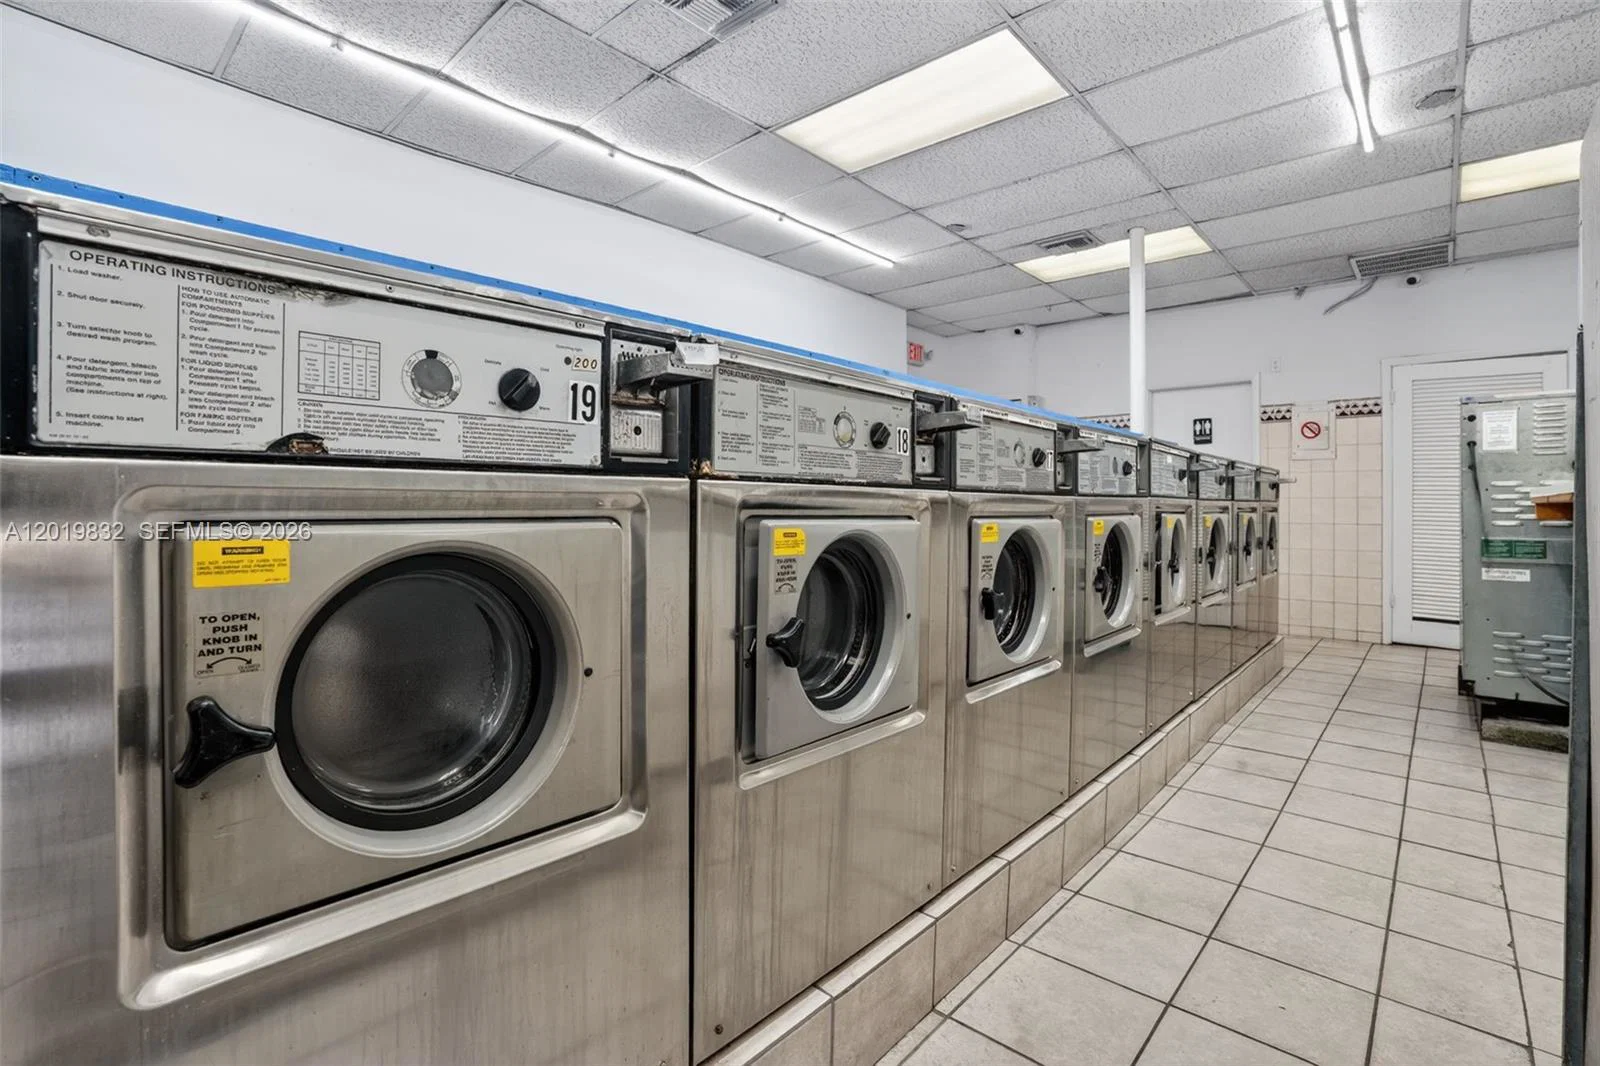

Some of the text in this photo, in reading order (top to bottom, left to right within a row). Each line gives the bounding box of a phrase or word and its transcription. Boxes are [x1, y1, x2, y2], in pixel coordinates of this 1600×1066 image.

[69, 250, 276, 294] OPERATING INSTRUCTIONS
[575, 357, 597, 369] 200
[571, 383, 596, 422] 19
[898, 429, 908, 453] 18
[199, 613, 260, 624] TO OPEN,
[213, 624, 248, 634] PUSH
[203, 636, 240, 646] KNOB
[198, 644, 262, 657] AND TURN
